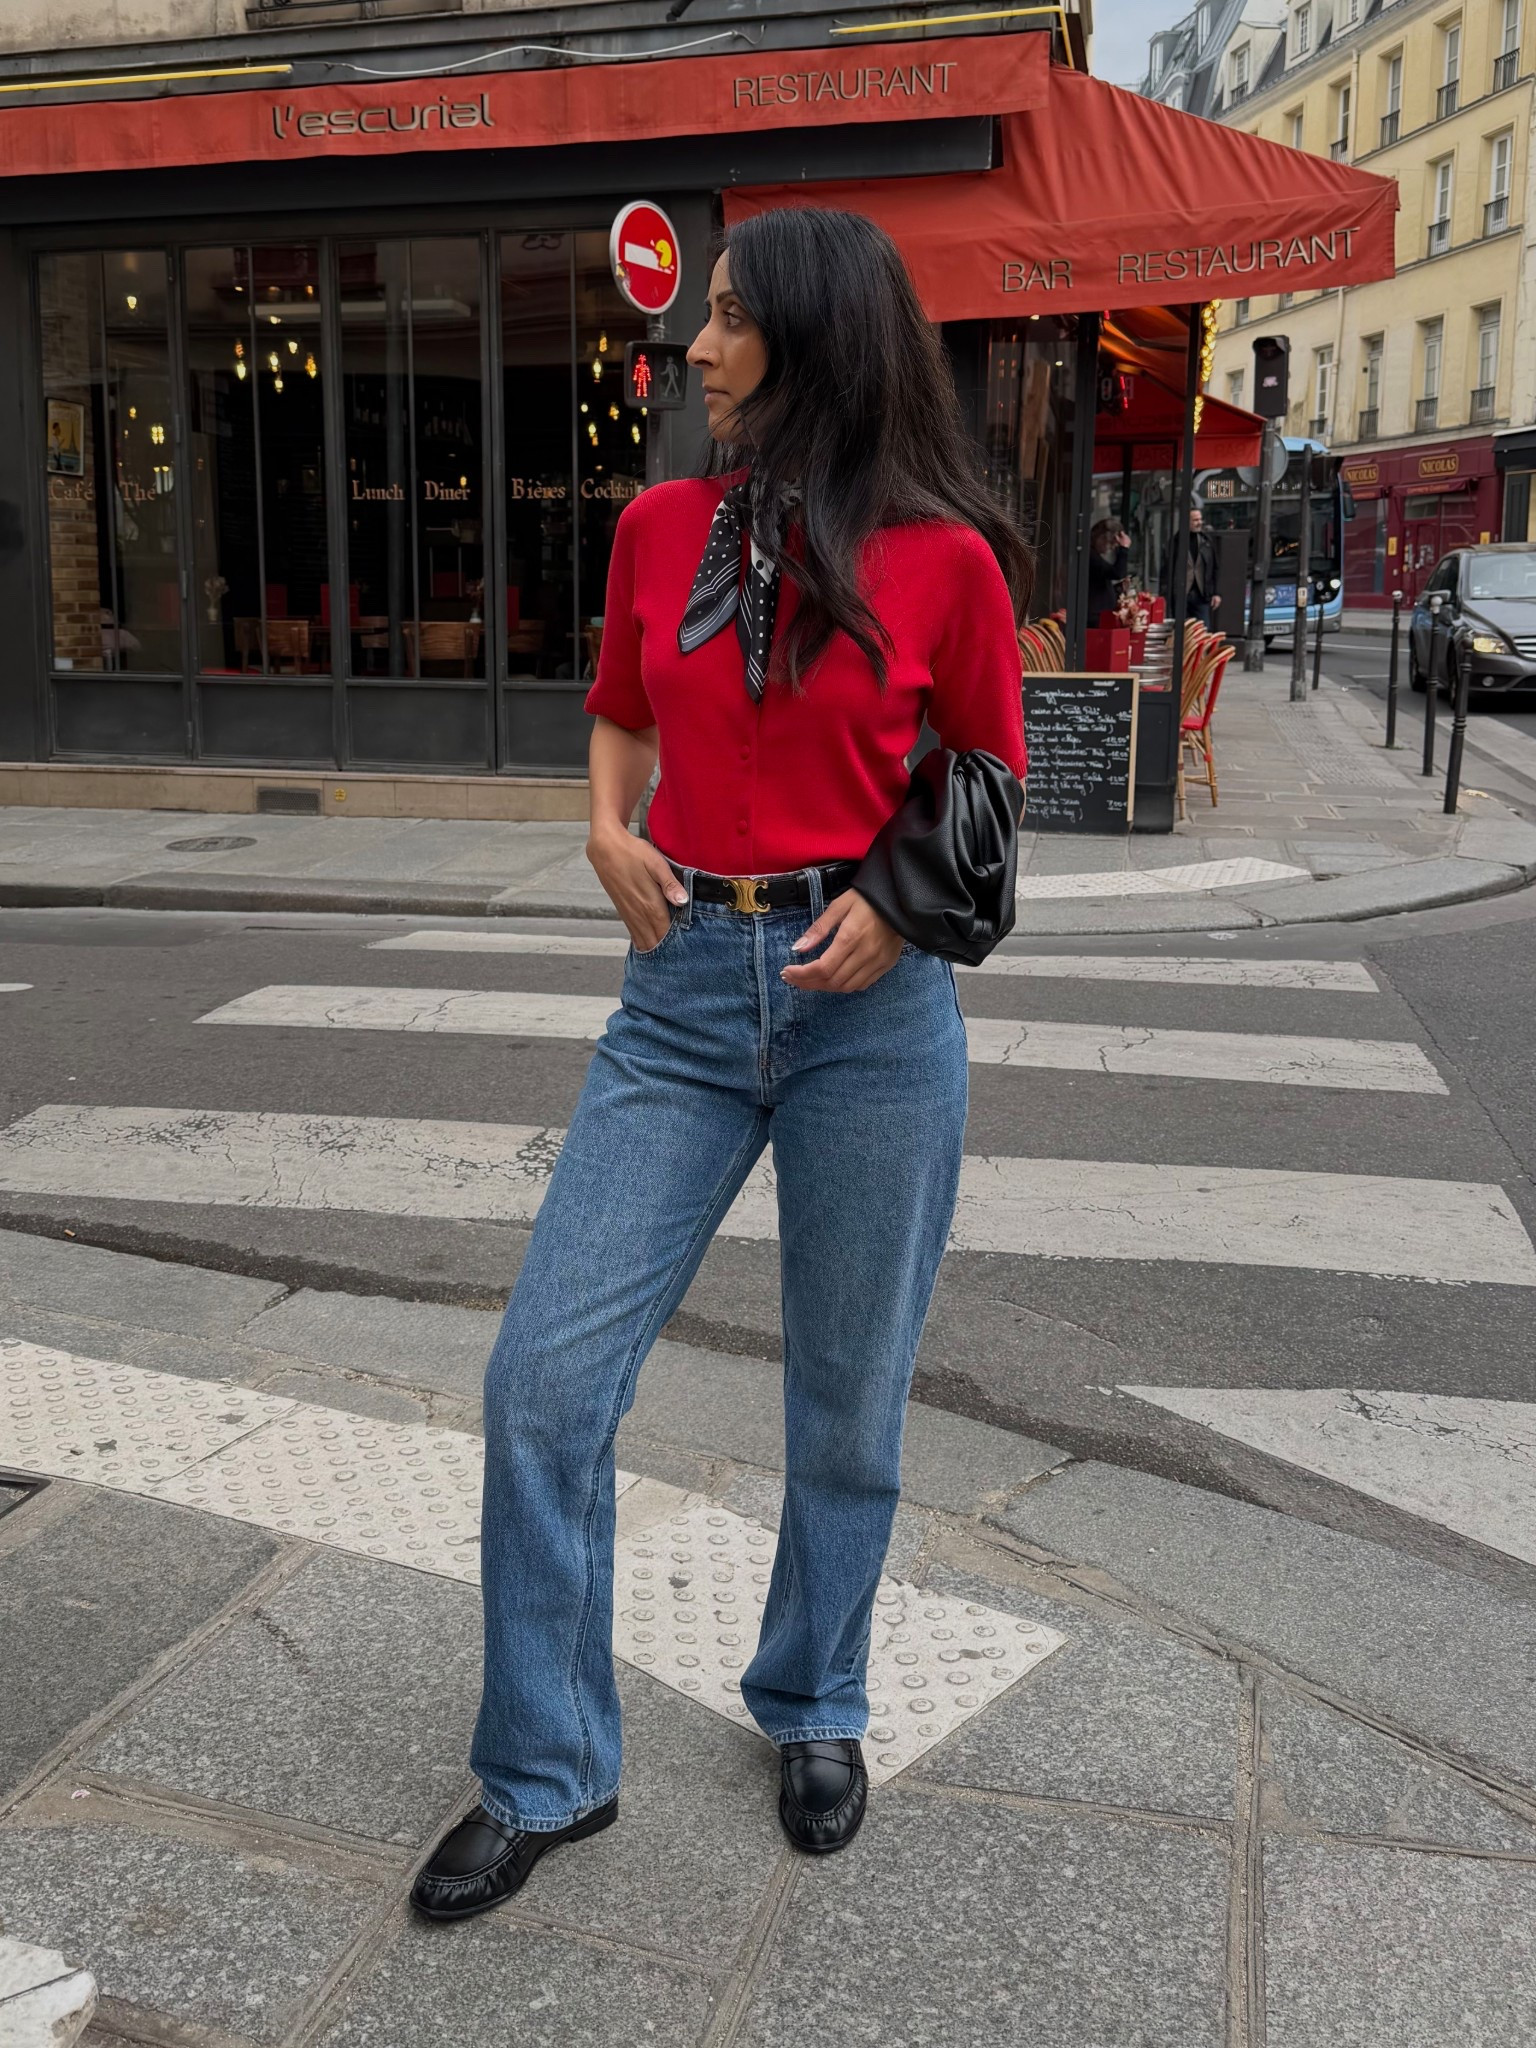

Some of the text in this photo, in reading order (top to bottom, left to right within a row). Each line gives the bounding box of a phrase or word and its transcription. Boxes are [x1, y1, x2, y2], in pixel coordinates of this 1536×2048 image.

[734, 62, 957, 108] RESTAURANT
[273, 93, 494, 139] l'escurial
[1002, 227, 1360, 292] BAR RESTAURANT
[1346, 468, 1377, 482] NICOLAS
[1422, 457, 1456, 473] NICOLAS
[50, 479, 157, 501] Café Thé
[351, 479, 405, 500] Lunch
[511, 478, 566, 499] Bières
